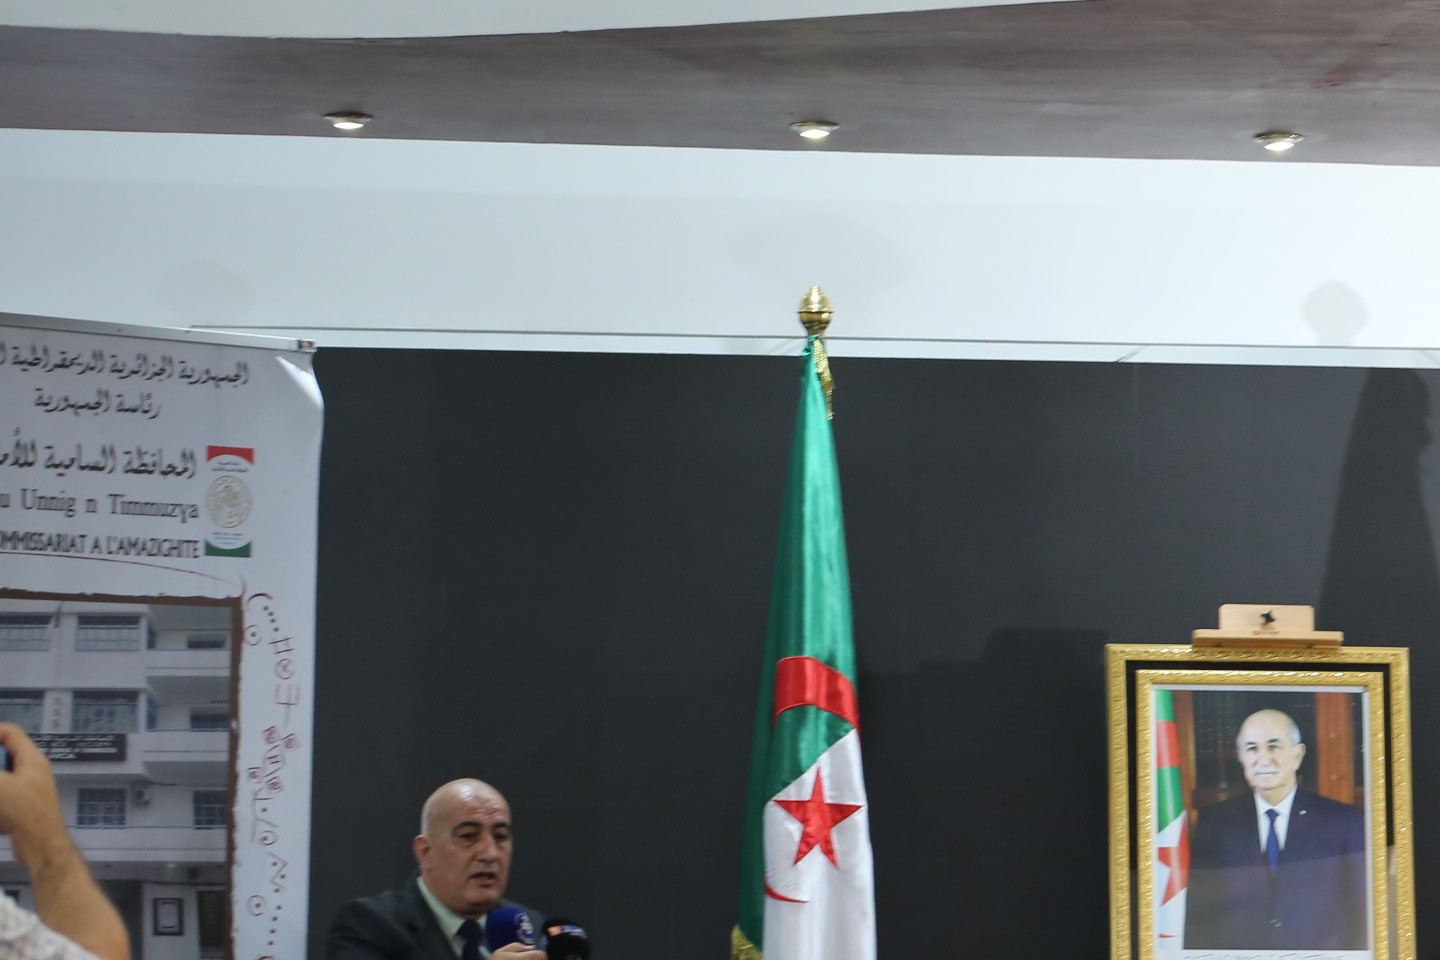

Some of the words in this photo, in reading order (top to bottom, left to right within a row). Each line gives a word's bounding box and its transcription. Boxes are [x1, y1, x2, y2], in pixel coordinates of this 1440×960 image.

[11, 344, 106, 374] الديمقراطية
[109, 352, 175, 382] الجزائرية
[178, 360, 250, 389] الجمهورية
[34, 387, 111, 416] الجمهورية
[115, 391, 162, 419] رئاسة
[44, 442, 117, 477] السامية
[123, 445, 197, 479] المحافظة
[20, 488, 77, 518] Unnig
[85, 498, 98, 513] n
